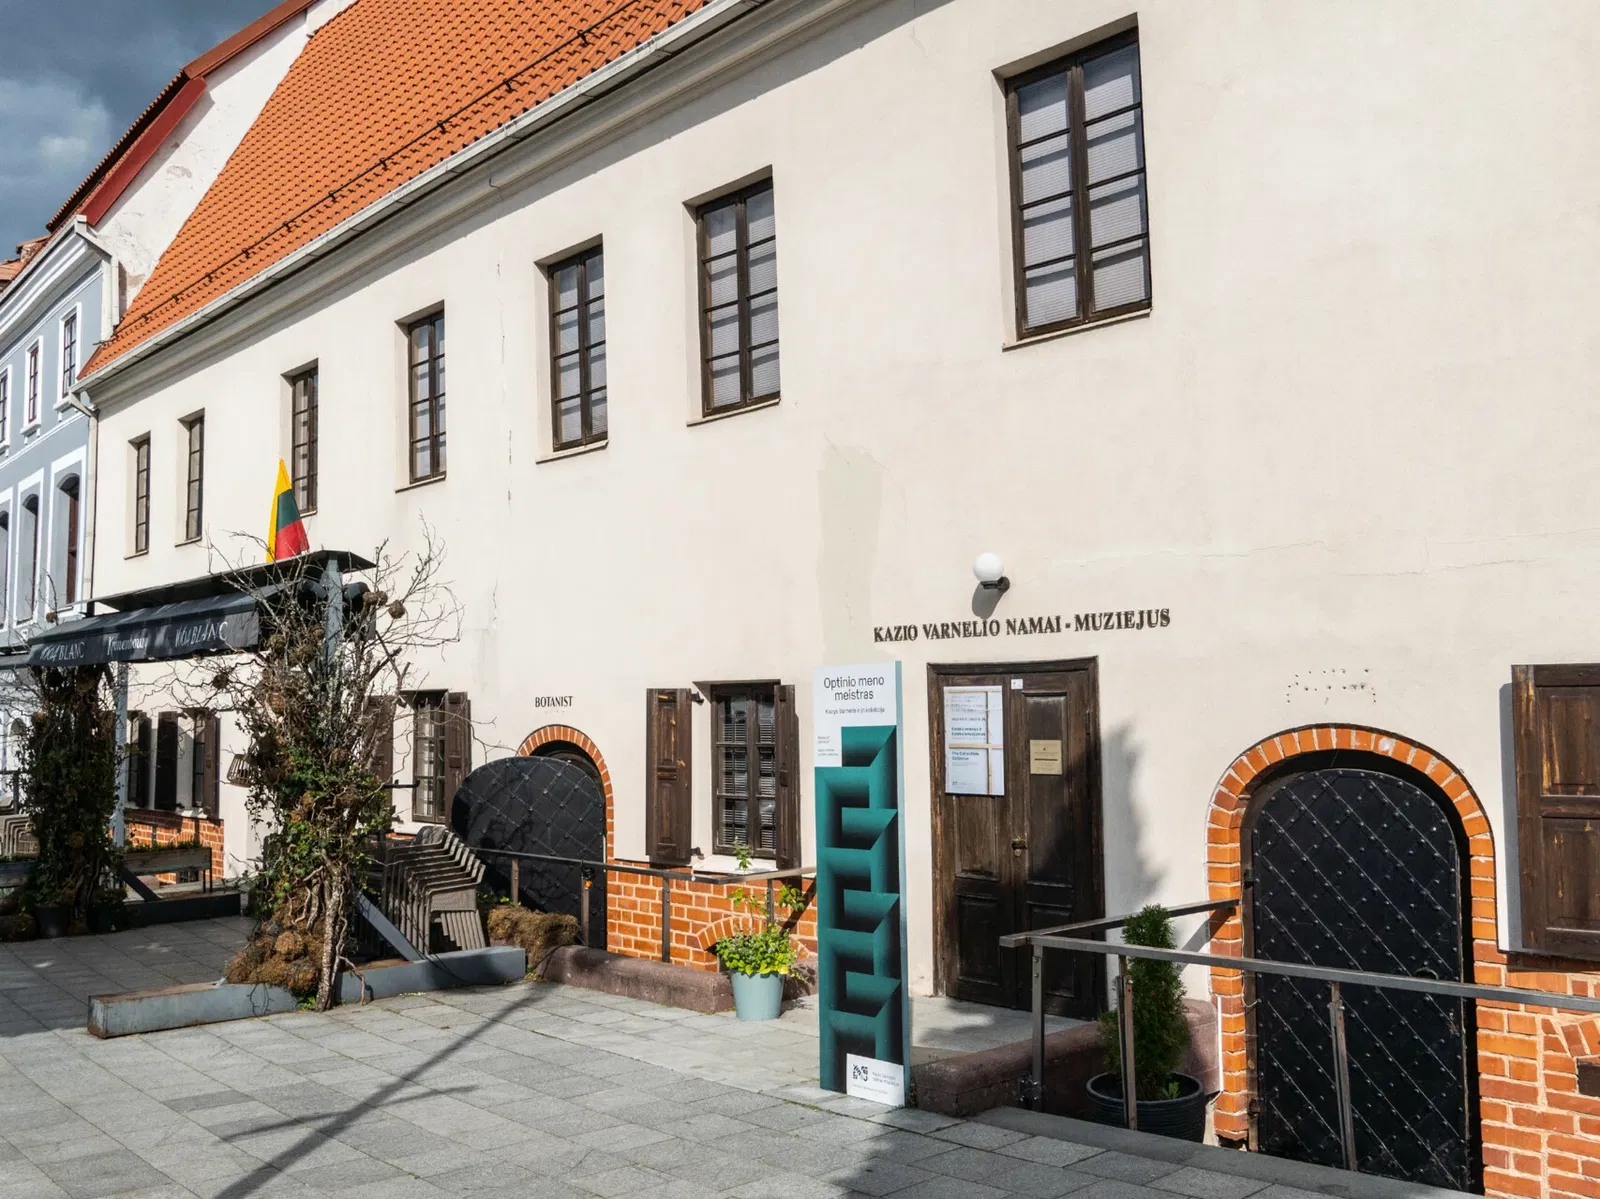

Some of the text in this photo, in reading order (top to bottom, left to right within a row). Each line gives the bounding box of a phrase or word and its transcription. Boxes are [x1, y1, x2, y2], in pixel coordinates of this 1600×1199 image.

[873, 624, 918, 643] KAZIO
[921, 617, 1001, 640] VARNELIO
[1005, 614, 1062, 636] NAMAI
[1074, 608, 1171, 633] MUZIEJUS
[59, 641, 86, 661] BLANC
[824, 676, 884, 690] Optinio meno
[534, 695, 573, 708] BOTANIST
[834, 689, 874, 700] meistras
